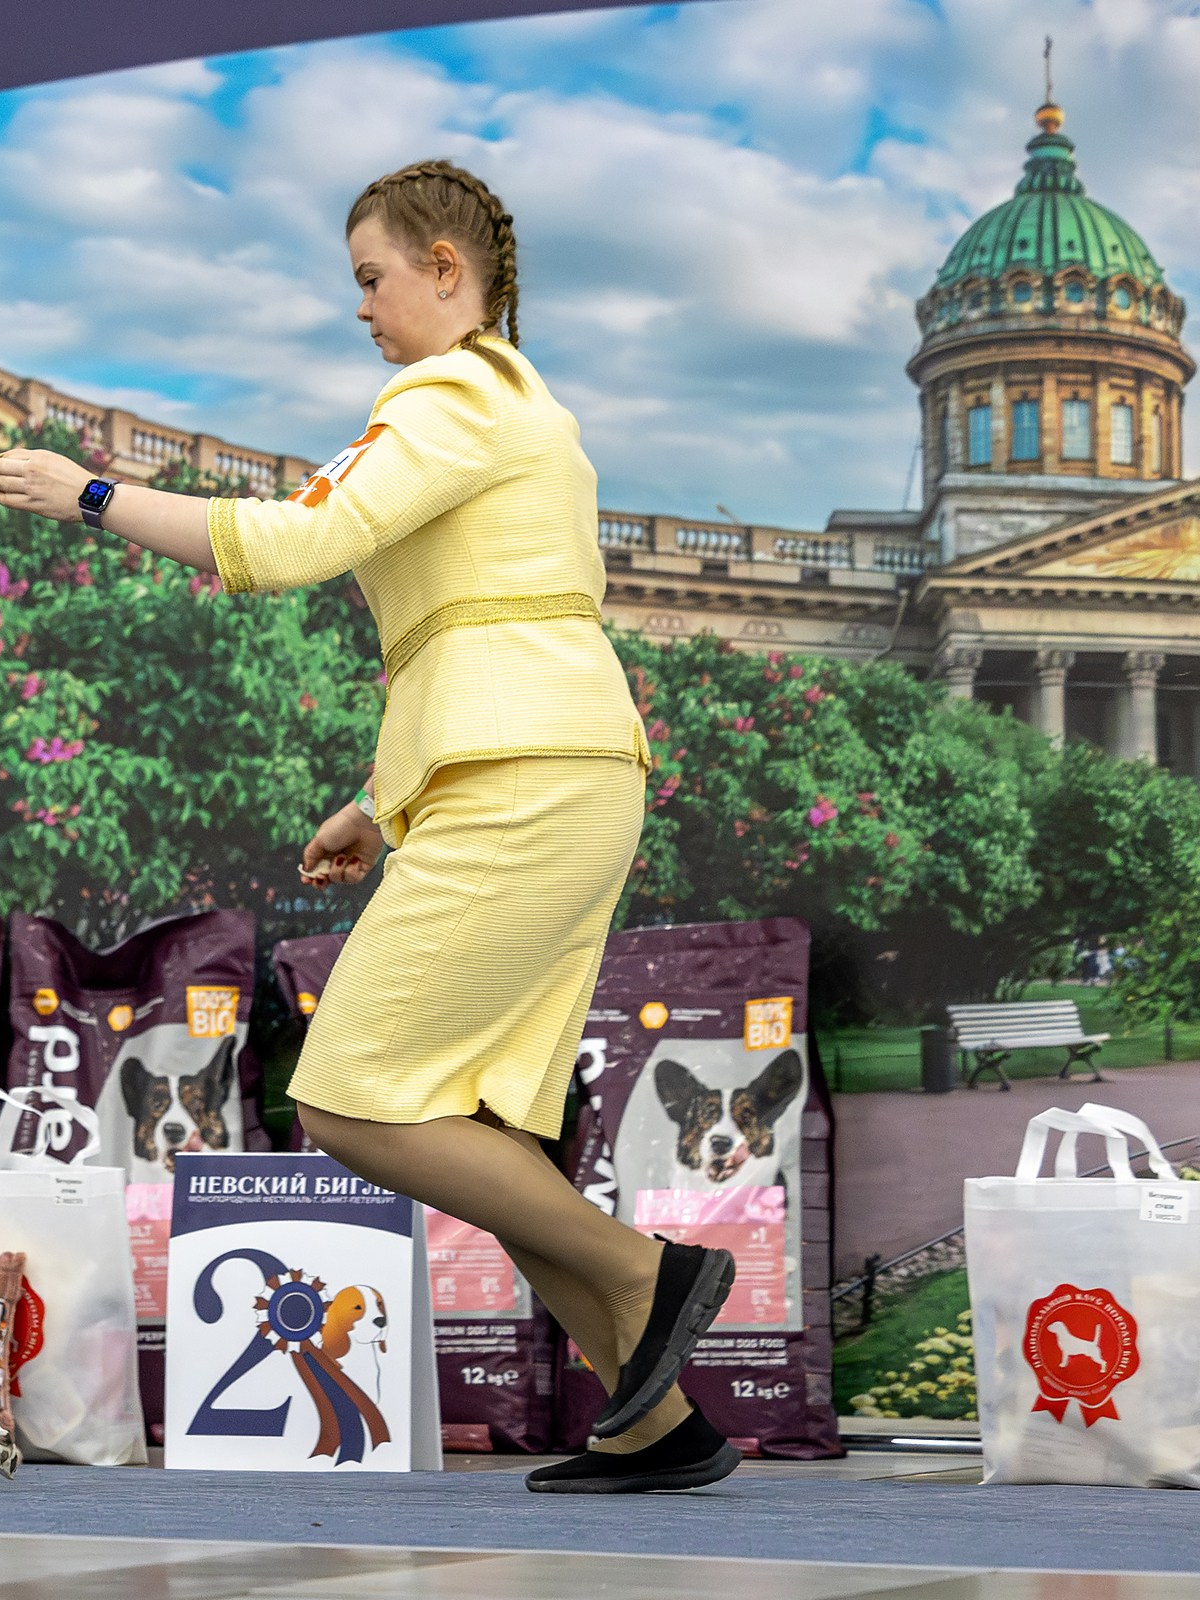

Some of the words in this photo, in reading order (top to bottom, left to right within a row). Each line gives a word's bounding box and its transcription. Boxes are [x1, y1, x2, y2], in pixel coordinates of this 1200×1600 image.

[749, 1022, 786, 1046] BIO
[189, 1172, 307, 1195] НЕВСКИЙ
[314, 1176, 396, 1195] БИГЛ
[185, 1248, 291, 1437] 2
